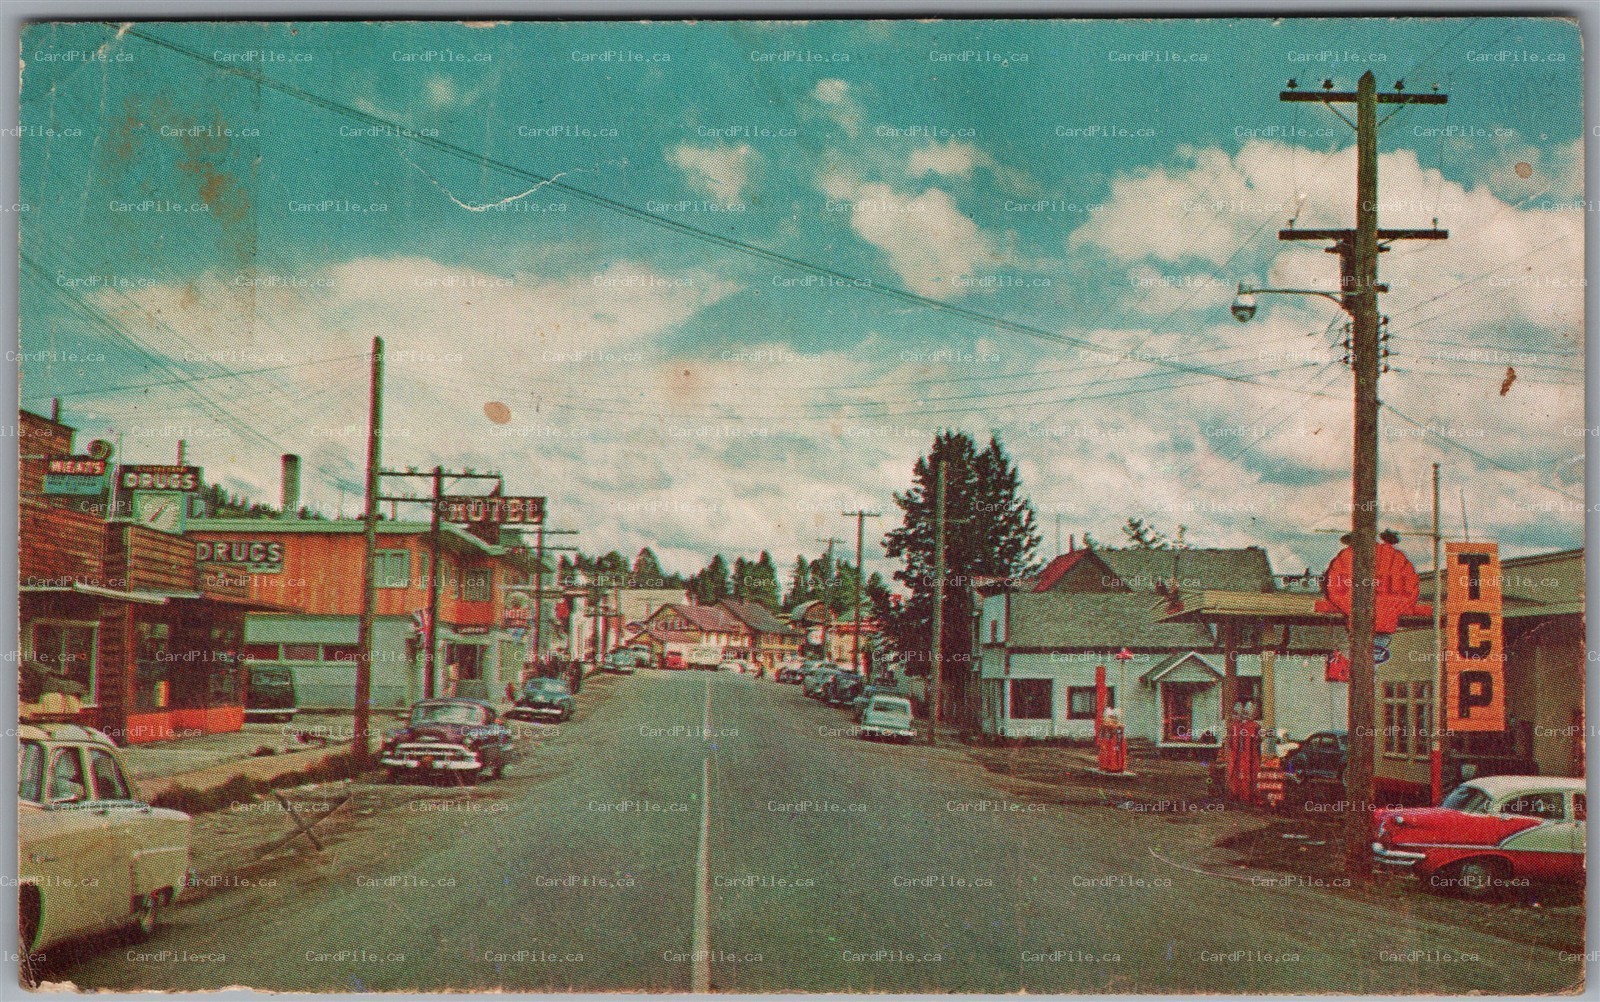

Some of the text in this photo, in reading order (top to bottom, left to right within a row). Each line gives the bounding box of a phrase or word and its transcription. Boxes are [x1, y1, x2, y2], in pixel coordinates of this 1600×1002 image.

[50, 460, 102, 474] MEATS
[124, 472, 196, 490] DRUGS
[448, 498, 543, 522] HOTEL
[195, 541, 282, 562] DRUGS
[1457, 553, 1494, 719] TCP
